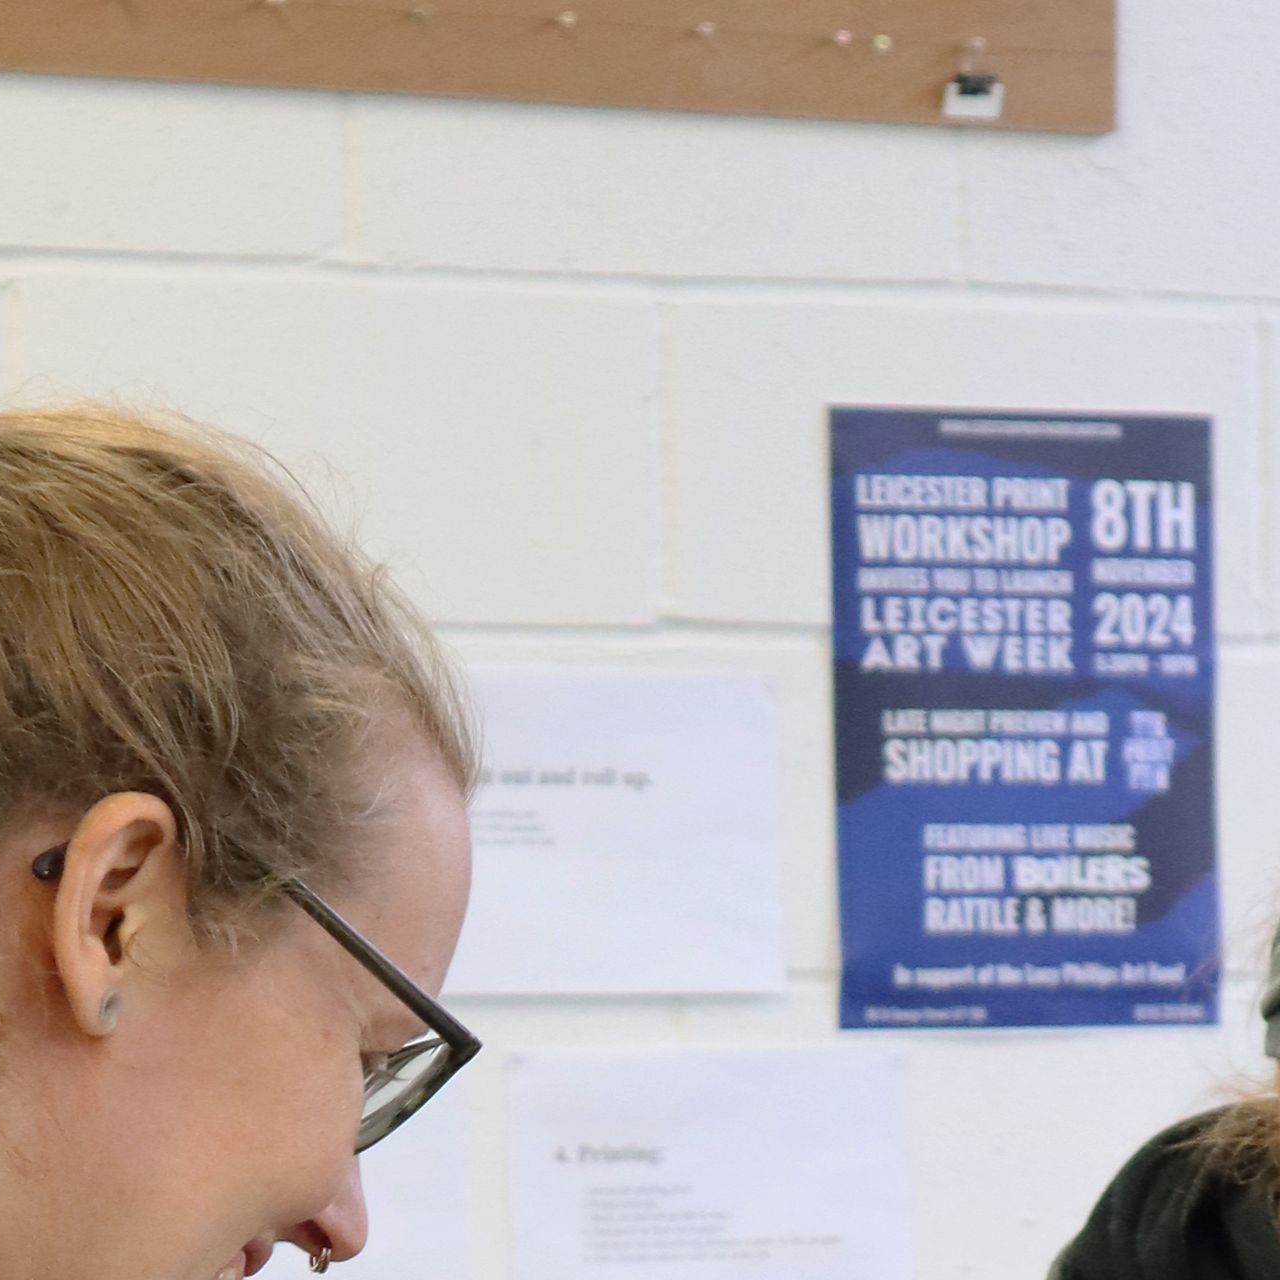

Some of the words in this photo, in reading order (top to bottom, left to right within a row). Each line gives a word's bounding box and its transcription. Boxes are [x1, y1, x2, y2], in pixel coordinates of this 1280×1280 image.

[855, 474, 987, 508] LEICESTER
[992, 476, 1069, 511] PRINT
[1091, 478, 1195, 552] 8TH
[857, 514, 1072, 562] WORKSHOP
[861, 597, 1073, 632] LEICESTER
[1093, 592, 1195, 647] 2024
[861, 634, 948, 671] ART
[961, 635, 1074, 672] WEEK
[882, 709, 927, 734] LATE
[883, 738, 1061, 784] SHOPPING
[1068, 739, 1108, 784] AT
[924, 855, 1005, 892] FROM
[924, 896, 1020, 933] RATTLE
[1024, 896, 1047, 933] &
